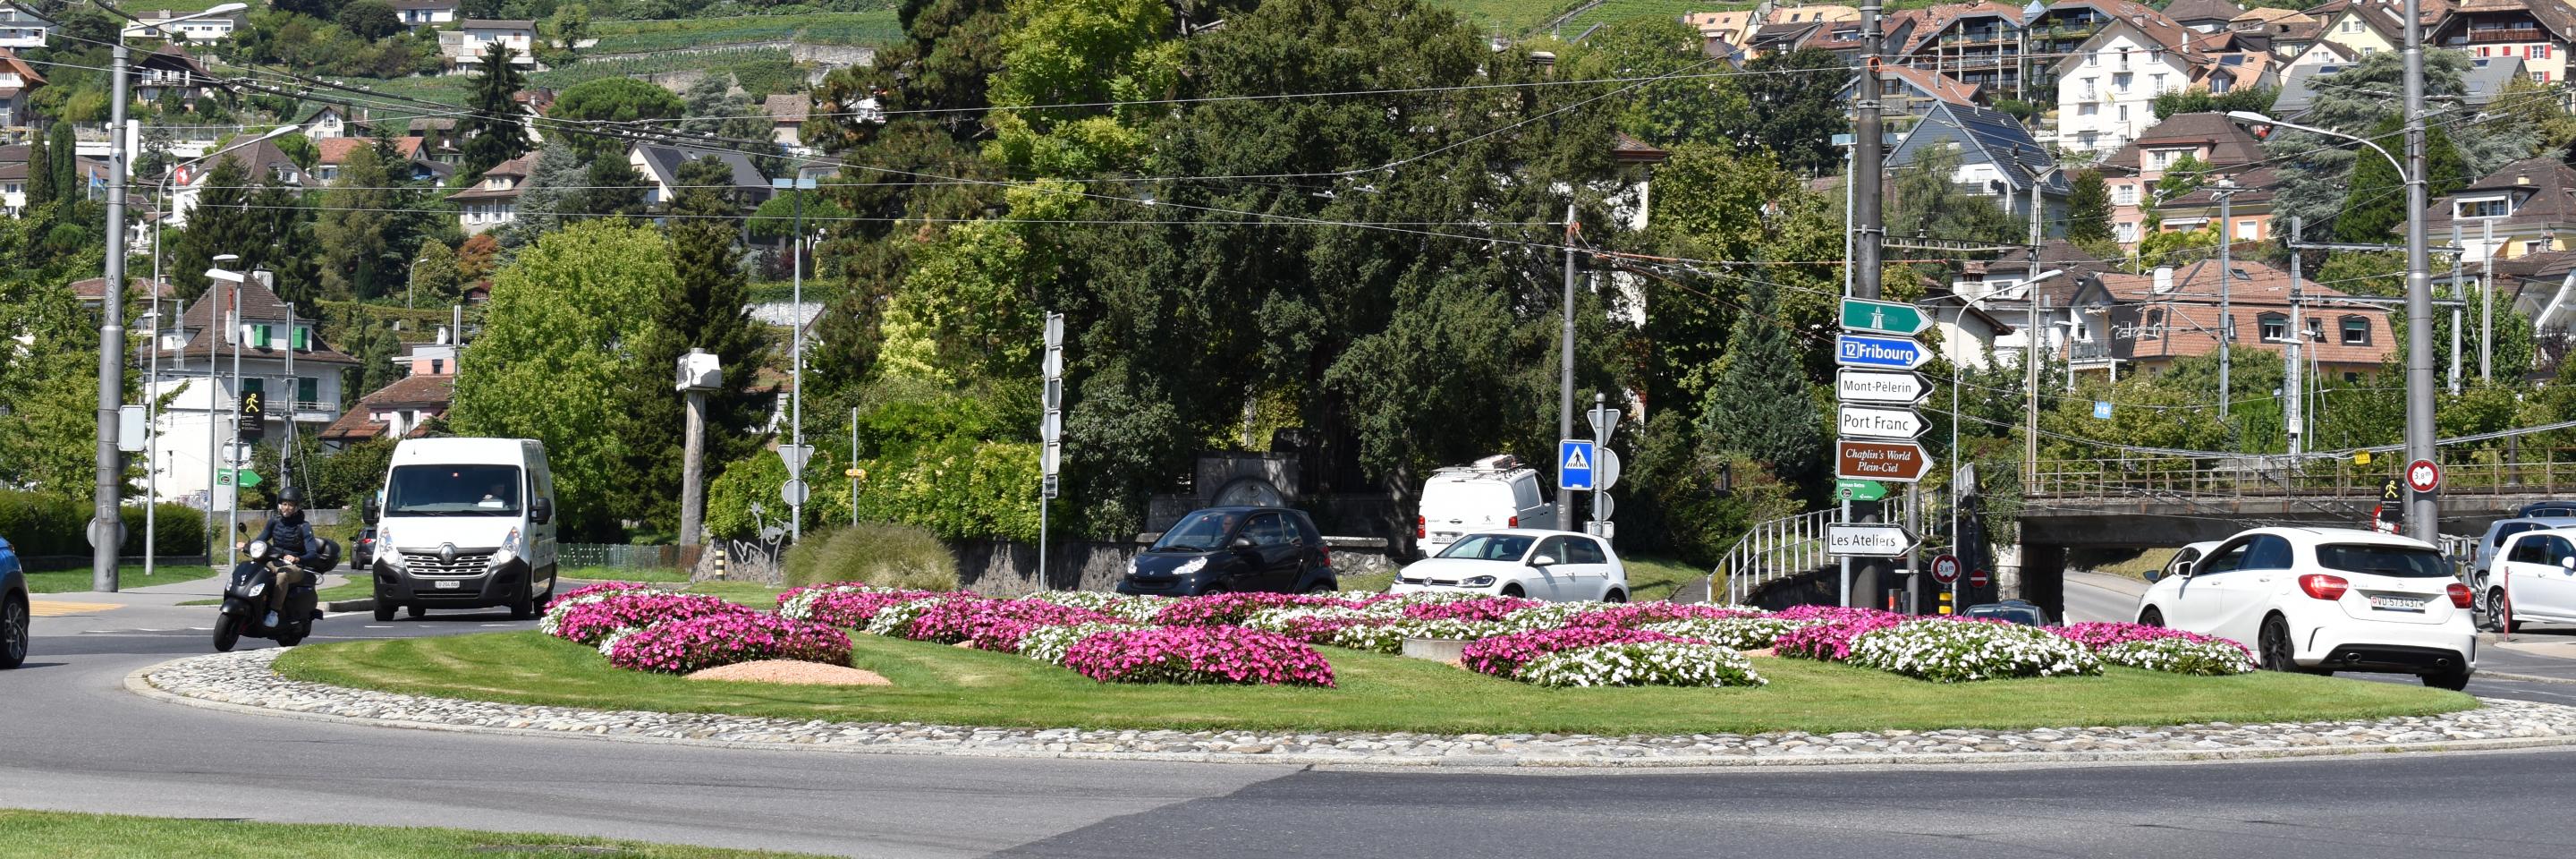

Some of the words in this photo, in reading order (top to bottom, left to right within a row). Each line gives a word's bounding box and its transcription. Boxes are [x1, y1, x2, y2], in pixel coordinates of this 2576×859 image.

[1844, 343, 1856, 356] 12
[1859, 344, 1914, 364] Fribourg
[1843, 379, 1911, 393] Mont-Pèlerin
[1843, 413, 1870, 429] Port
[1875, 416, 1909, 430] Franc
[1845, 448, 1885, 461] Chaplin's
[1886, 450, 1911, 461] World
[1857, 461, 1899, 472] Plein-Ciel
[1831, 534, 1849, 546] Les
[1852, 534, 1896, 547] Ateliers
[2377, 596, 2387, 606] VD
